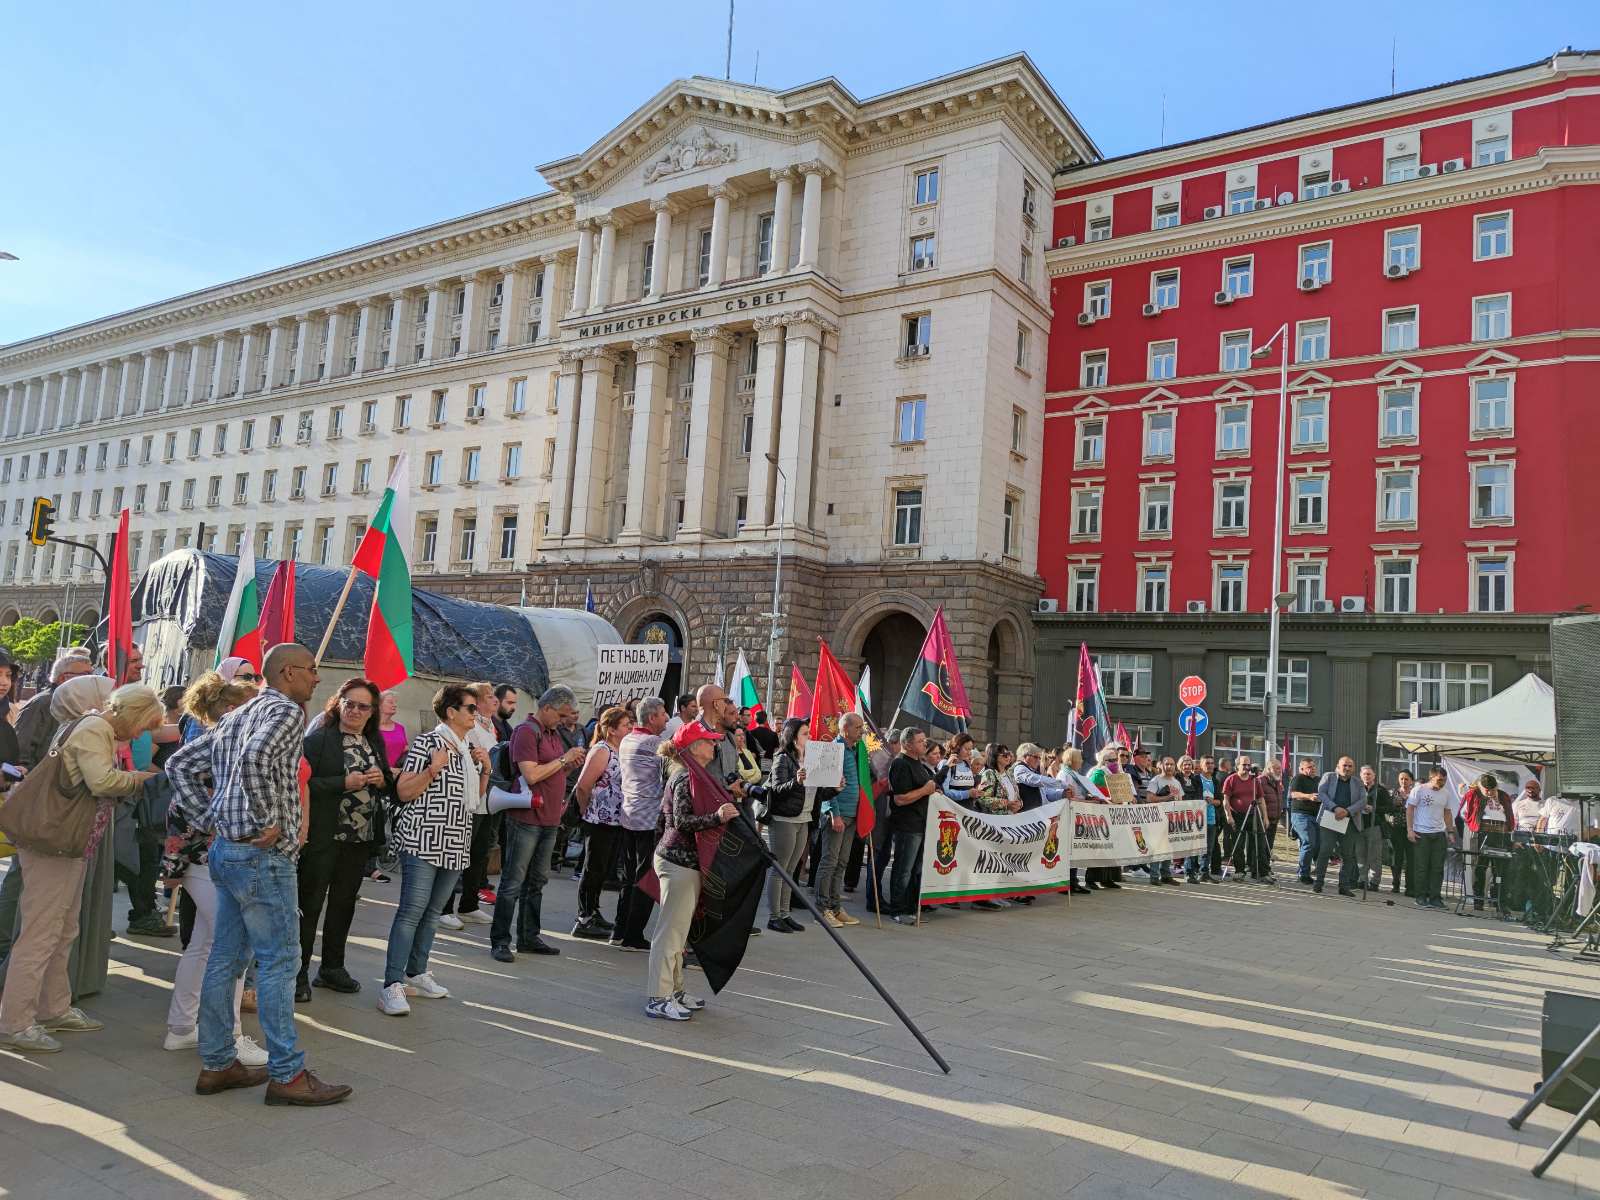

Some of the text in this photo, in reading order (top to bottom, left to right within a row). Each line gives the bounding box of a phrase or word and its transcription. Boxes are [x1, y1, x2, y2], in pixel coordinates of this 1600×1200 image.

[579, 290, 787, 338] МИНИСТЕРСКИ СЪВЕТ
[649, 649, 664, 663] ТИ
[598, 671, 611, 685] СИ
[1182, 685, 1203, 697] STOP
[1165, 808, 1205, 834] ВМРО
